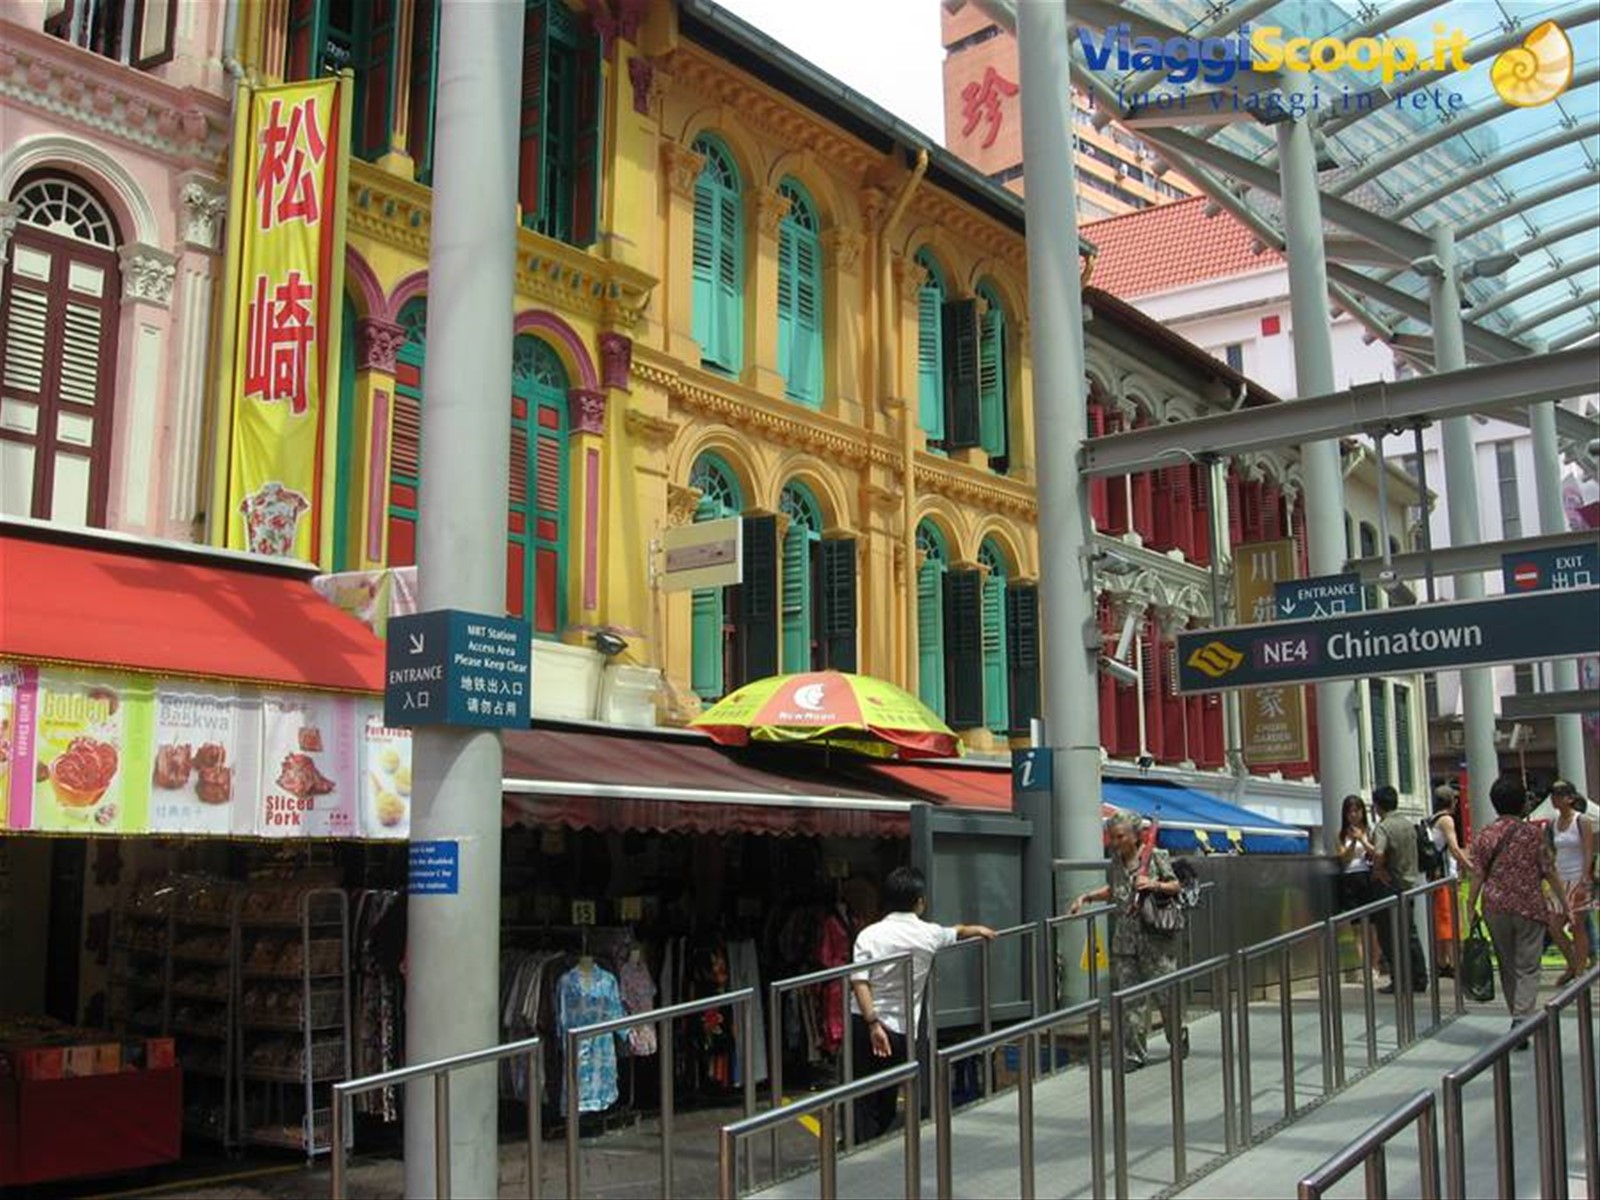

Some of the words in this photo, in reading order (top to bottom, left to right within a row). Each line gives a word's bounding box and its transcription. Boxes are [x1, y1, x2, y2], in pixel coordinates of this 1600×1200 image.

[244, 97, 326, 414] 松崎
[1556, 555, 1582, 570] EXIT
[1298, 582, 1356, 600] ENTRANCE
[1552, 571, 1591, 591] 出口
[1311, 599, 1346, 619] 入口
[488, 627, 517, 642] Station
[1263, 639, 1309, 664] NE4
[1327, 624, 1483, 661] Chinatown
[468, 640, 496, 655] Access
[497, 644, 516, 657] Area
[454, 652, 482, 668] Please
[484, 657, 505, 672] Keep
[507, 659, 527, 673] Clear
[390, 664, 443, 685] ENTRANCE
[461, 675, 523, 696] 地铁出入口
[403, 691, 430, 709] 入口
[467, 697, 517, 717] 请勿占用
[266, 796, 314, 811] Sliced
[265, 811, 301, 826] Pork
